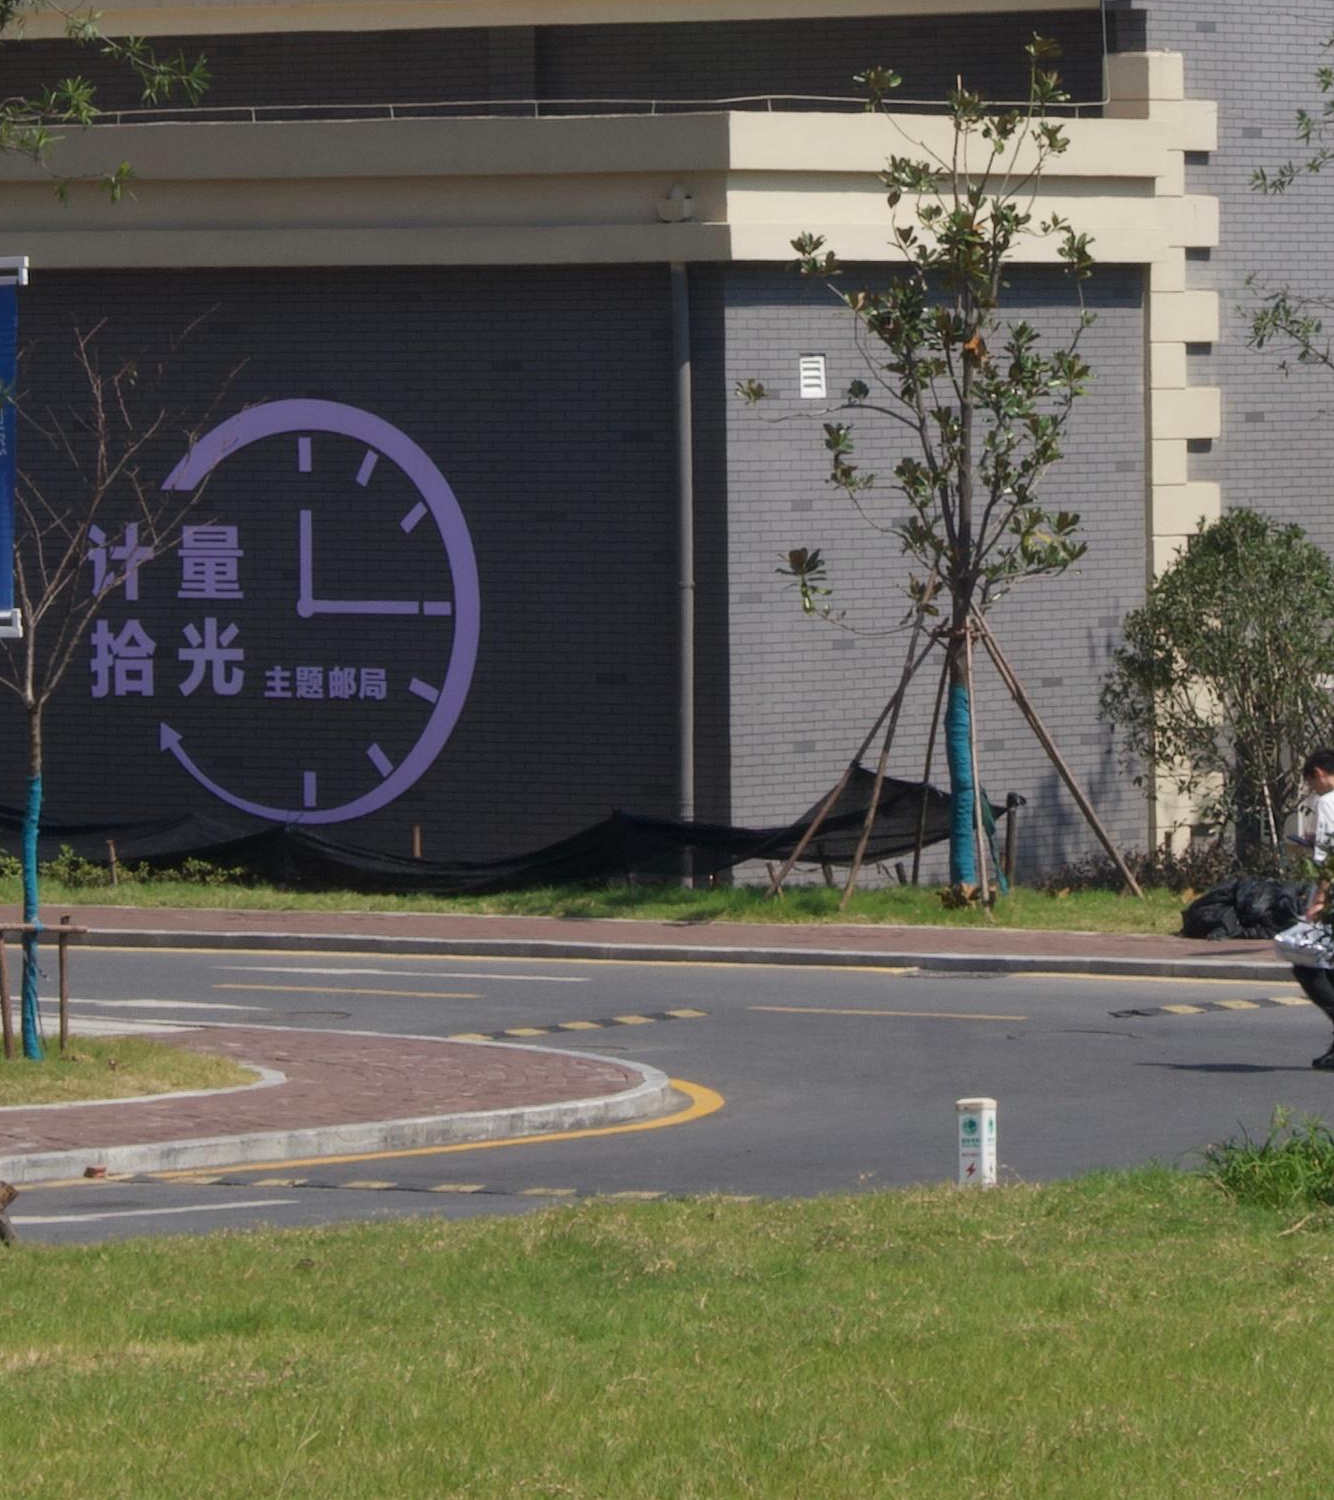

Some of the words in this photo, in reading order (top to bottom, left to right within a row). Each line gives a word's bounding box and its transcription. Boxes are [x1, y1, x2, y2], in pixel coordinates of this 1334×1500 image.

[87, 521, 245, 601] 计量
[89, 616, 246, 699] 拾光
[264, 665, 388, 700] 主题邮局
